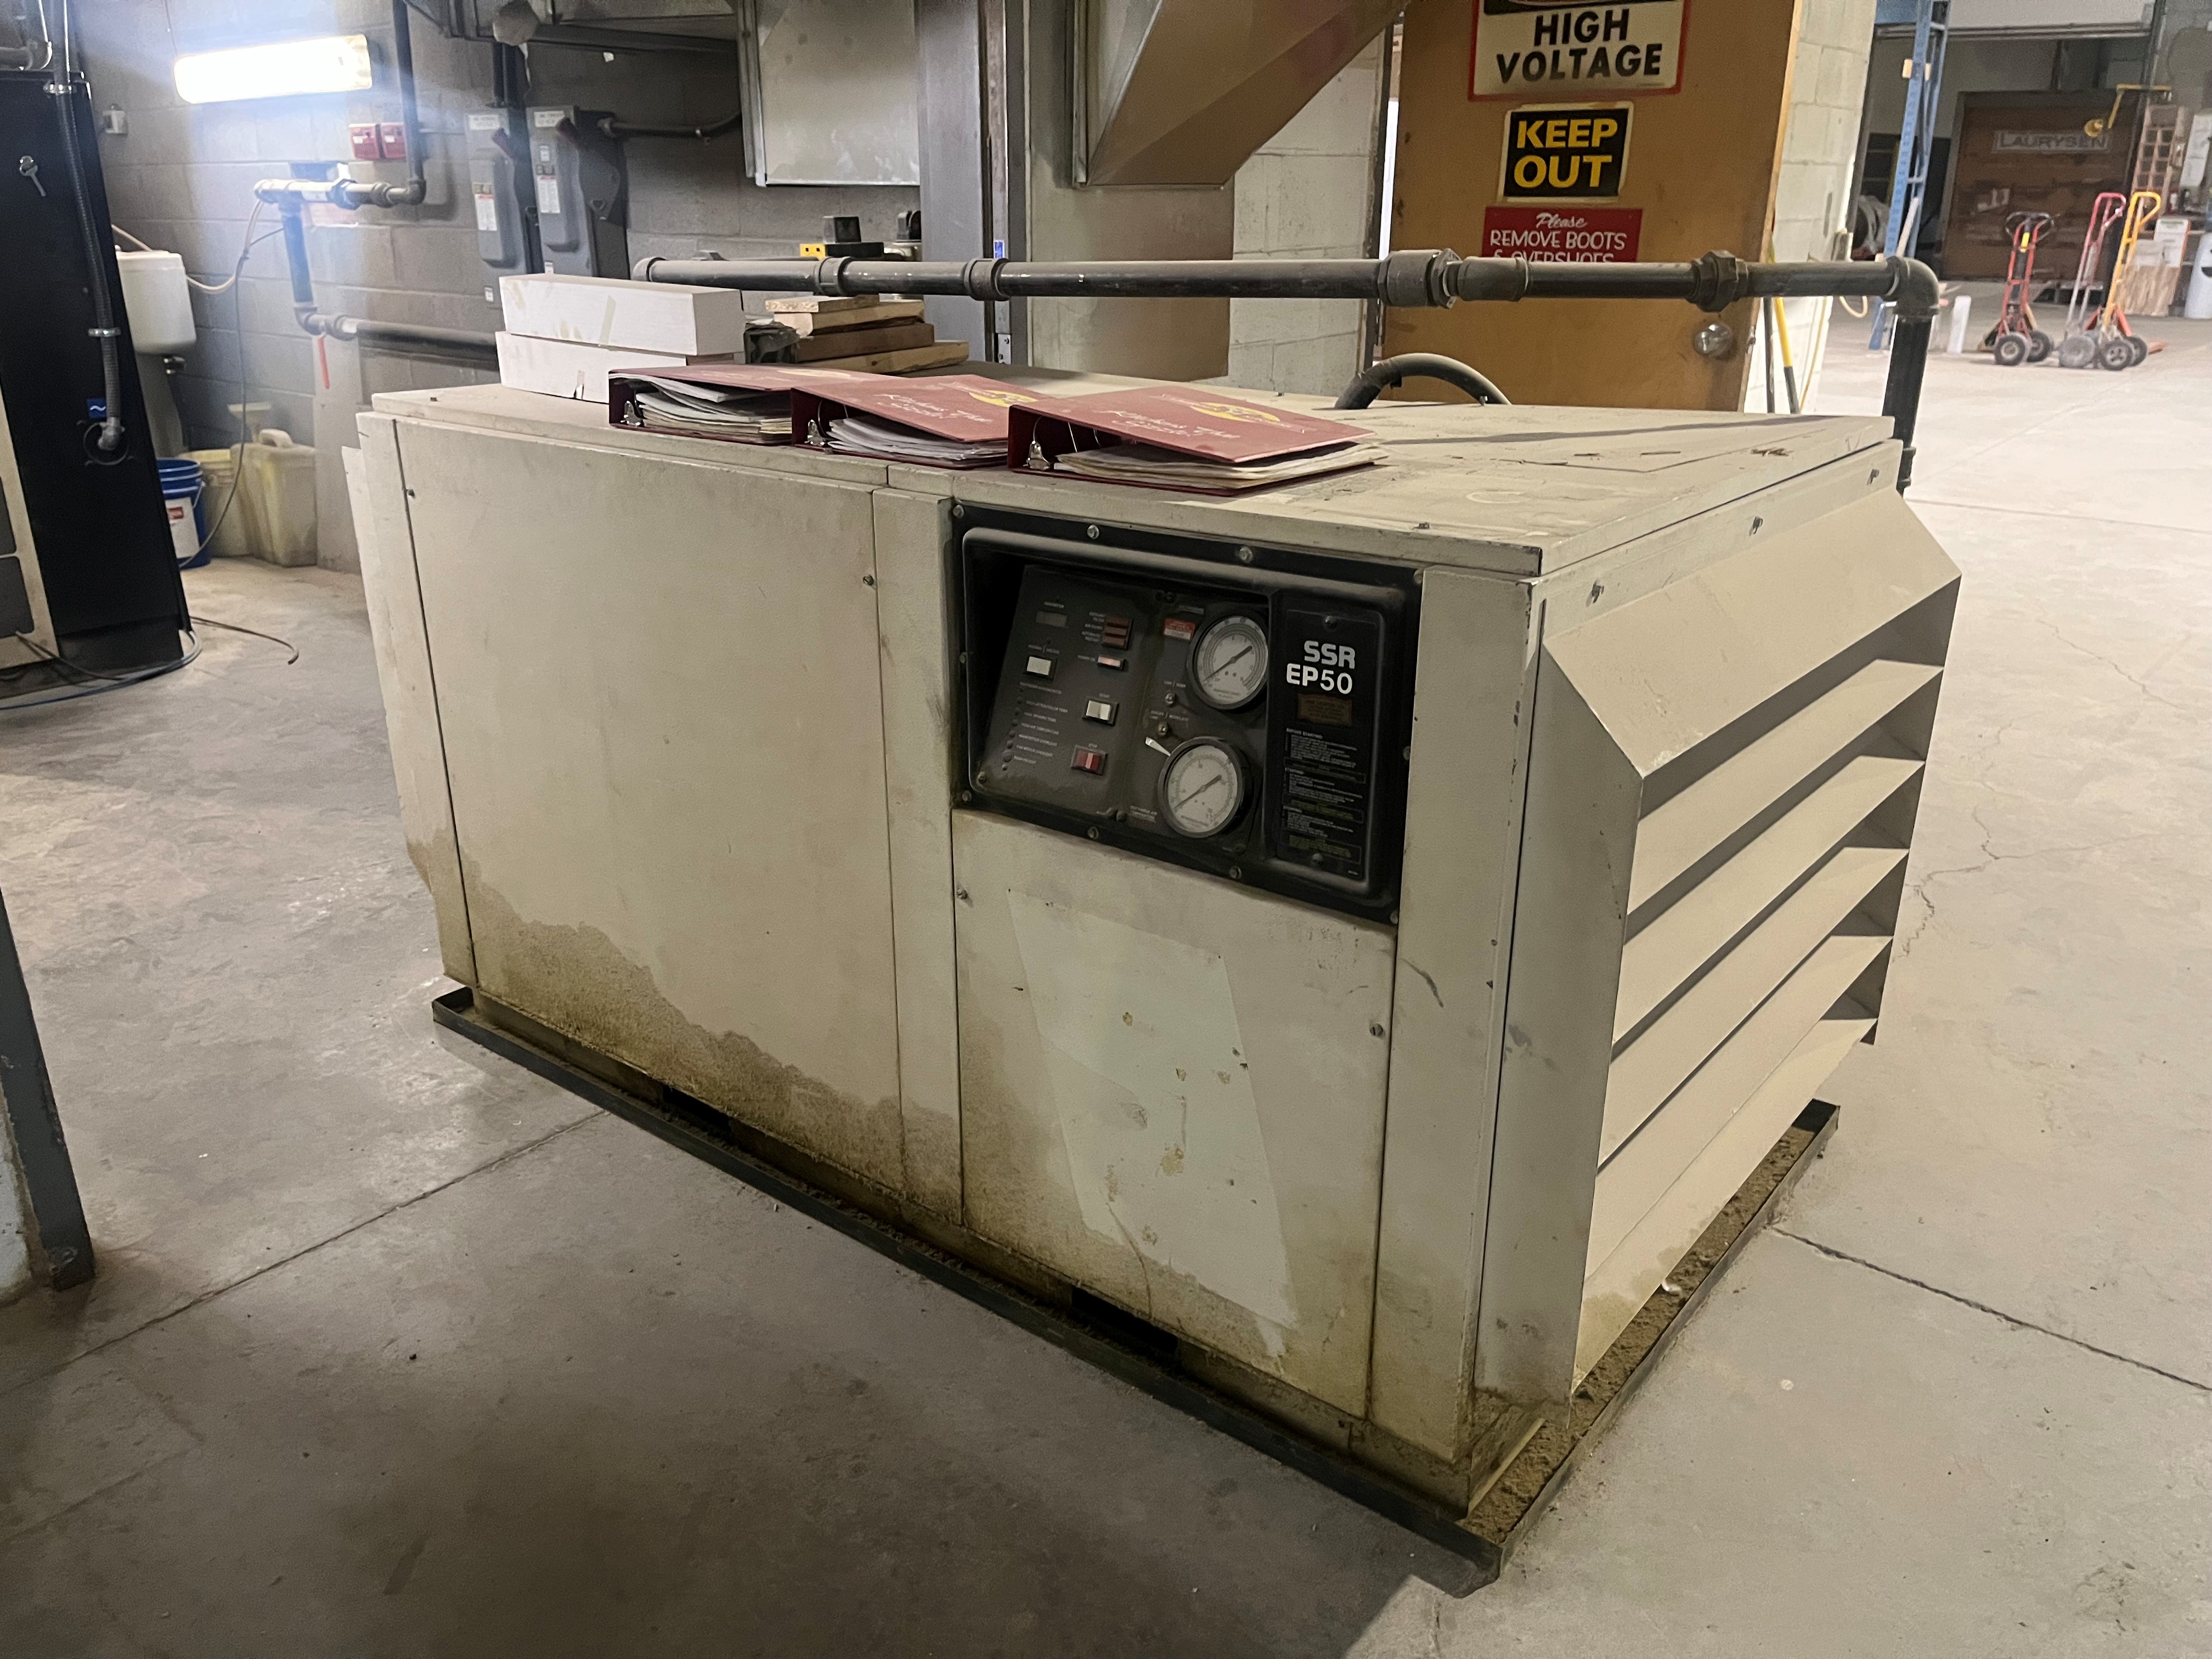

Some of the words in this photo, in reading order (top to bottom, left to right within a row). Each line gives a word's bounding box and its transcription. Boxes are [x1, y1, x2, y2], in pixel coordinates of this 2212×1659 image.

[1534, 9, 1629, 47] HIGH
[1496, 43, 1662, 84] VOLTAGE
[1517, 118, 1618, 148] KEEP
[1514, 155, 1612, 188] OUT
[1536, 212, 1587, 229] Please
[1490, 229, 1561, 248] REMOVE
[1566, 231, 1627, 250] BOOTS
[1304, 640, 1355, 669] SSR
[1286, 663, 1353, 695] EP50
